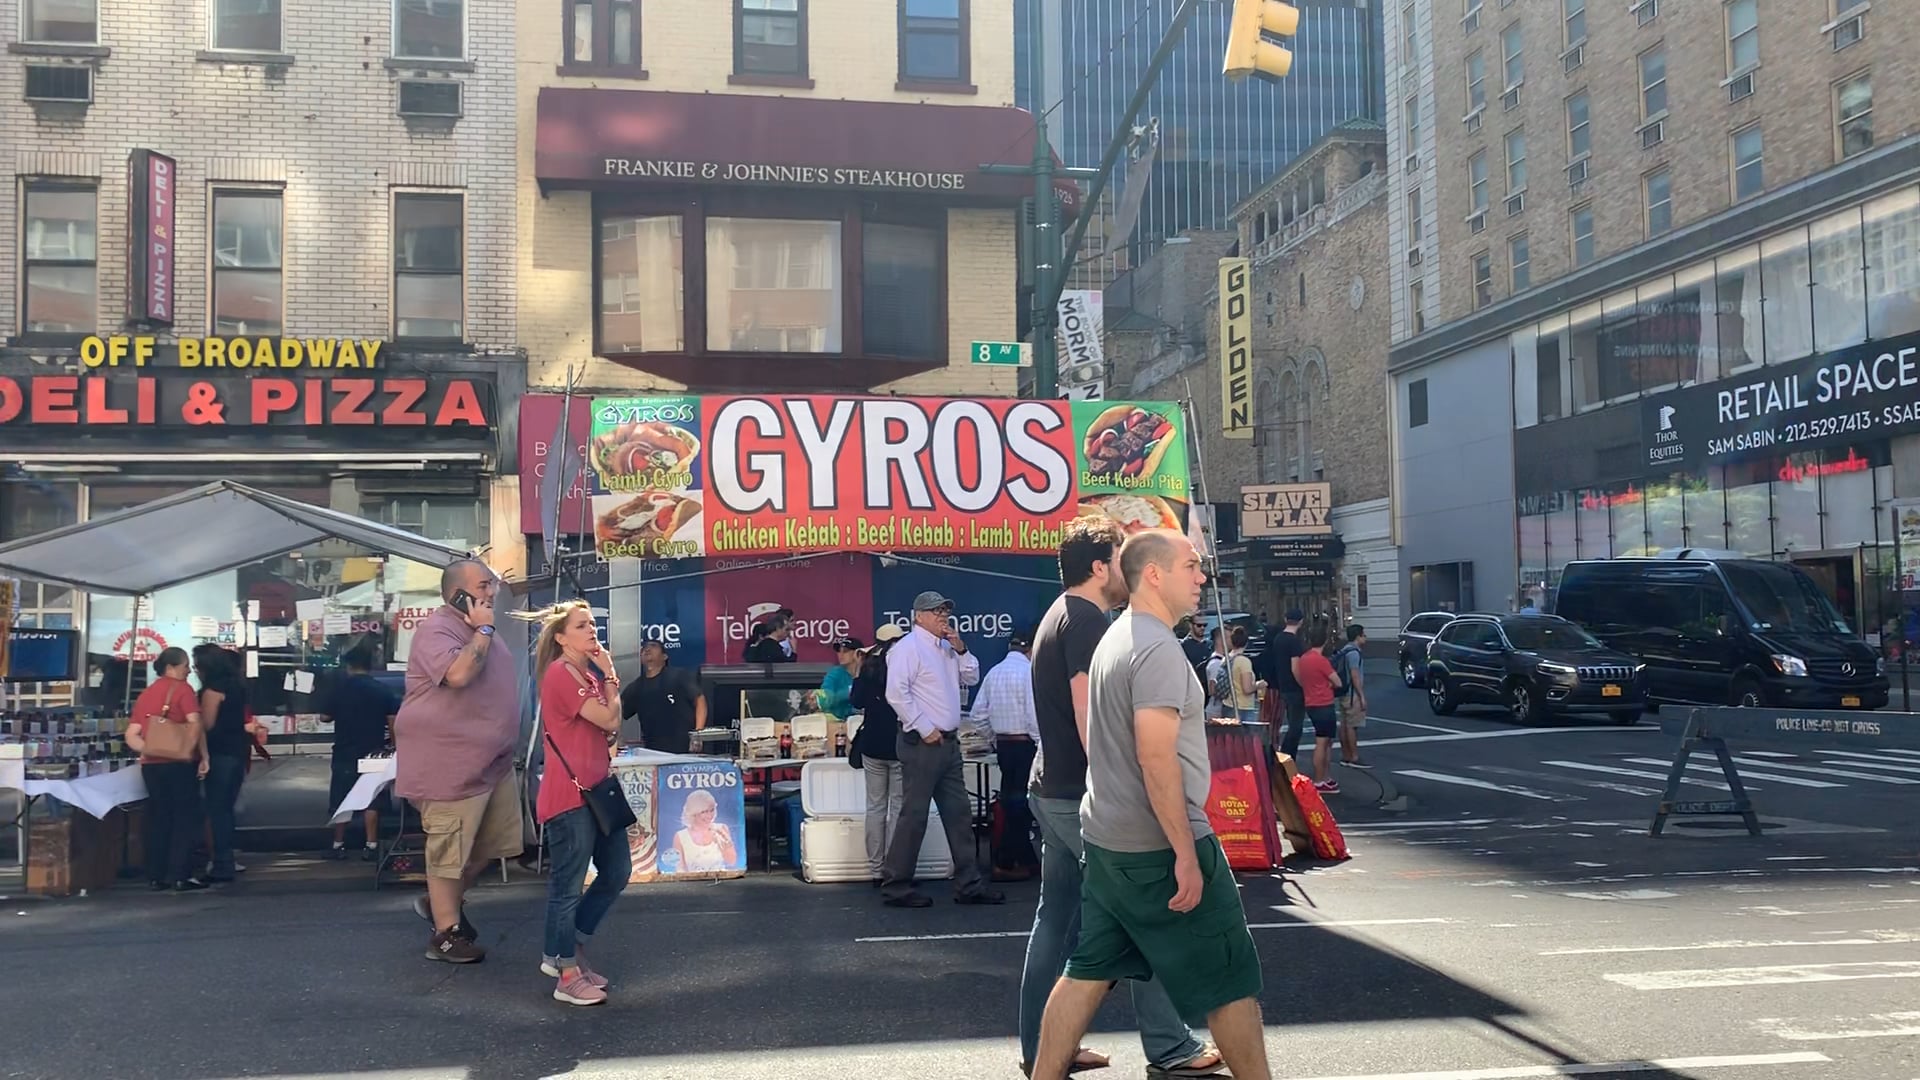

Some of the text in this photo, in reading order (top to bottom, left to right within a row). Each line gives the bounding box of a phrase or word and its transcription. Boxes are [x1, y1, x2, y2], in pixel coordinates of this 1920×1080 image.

[604, 159, 965, 190] FRANKIE & JOHNNIE'S STEAKHOUSE
[153, 159, 168, 317] DELI & PIZZA
[80, 336, 383, 369] OFF BROADWAY
[979, 344, 1012, 362] 8 AV
[1227, 264, 1248, 433] GOLDEN
[1717, 347, 1919, 424] RETAIL SPACE
[181, 381, 227, 425] &
[250, 377, 487, 427] PIZZA
[595, 403, 694, 424] GYROS
[1655, 430, 1679, 444] THOR
[1708, 437, 1735, 456] SAM
[1736, 428, 1776, 451] SABIN
[1785, 410, 1872, 443] 212.529.7413
[708, 398, 1072, 515] GYROS
[1650, 443, 1684, 460] EQUITIES
[600, 470, 647, 491] Lamb
[653, 468, 694, 491] Gyro
[1081, 471, 1184, 490] Beef Kebab Pita
[1242, 489, 1321, 511] SLAVE
[1266, 507, 1330, 528] PLAY
[713, 519, 779, 551] Chicken
[785, 516, 842, 549] Kebab
[857, 515, 897, 547] Beef
[900, 516, 955, 549] Kebab
[969, 518, 1013, 549] Lamb
[602, 538, 698, 558] Beef Gyro
[642, 561, 671, 572] ffice.
[716, 613, 850, 645] Telarge
[883, 609, 1013, 639] Telarge
[622, 769, 652, 783] CA'S
[681, 765, 721, 773] OLYMPIA
[626, 782, 652, 795] ROS
[666, 771, 737, 790] GYROS
[1219, 799, 1249, 809] ROYAL
[1226, 807, 1246, 816] OAK
